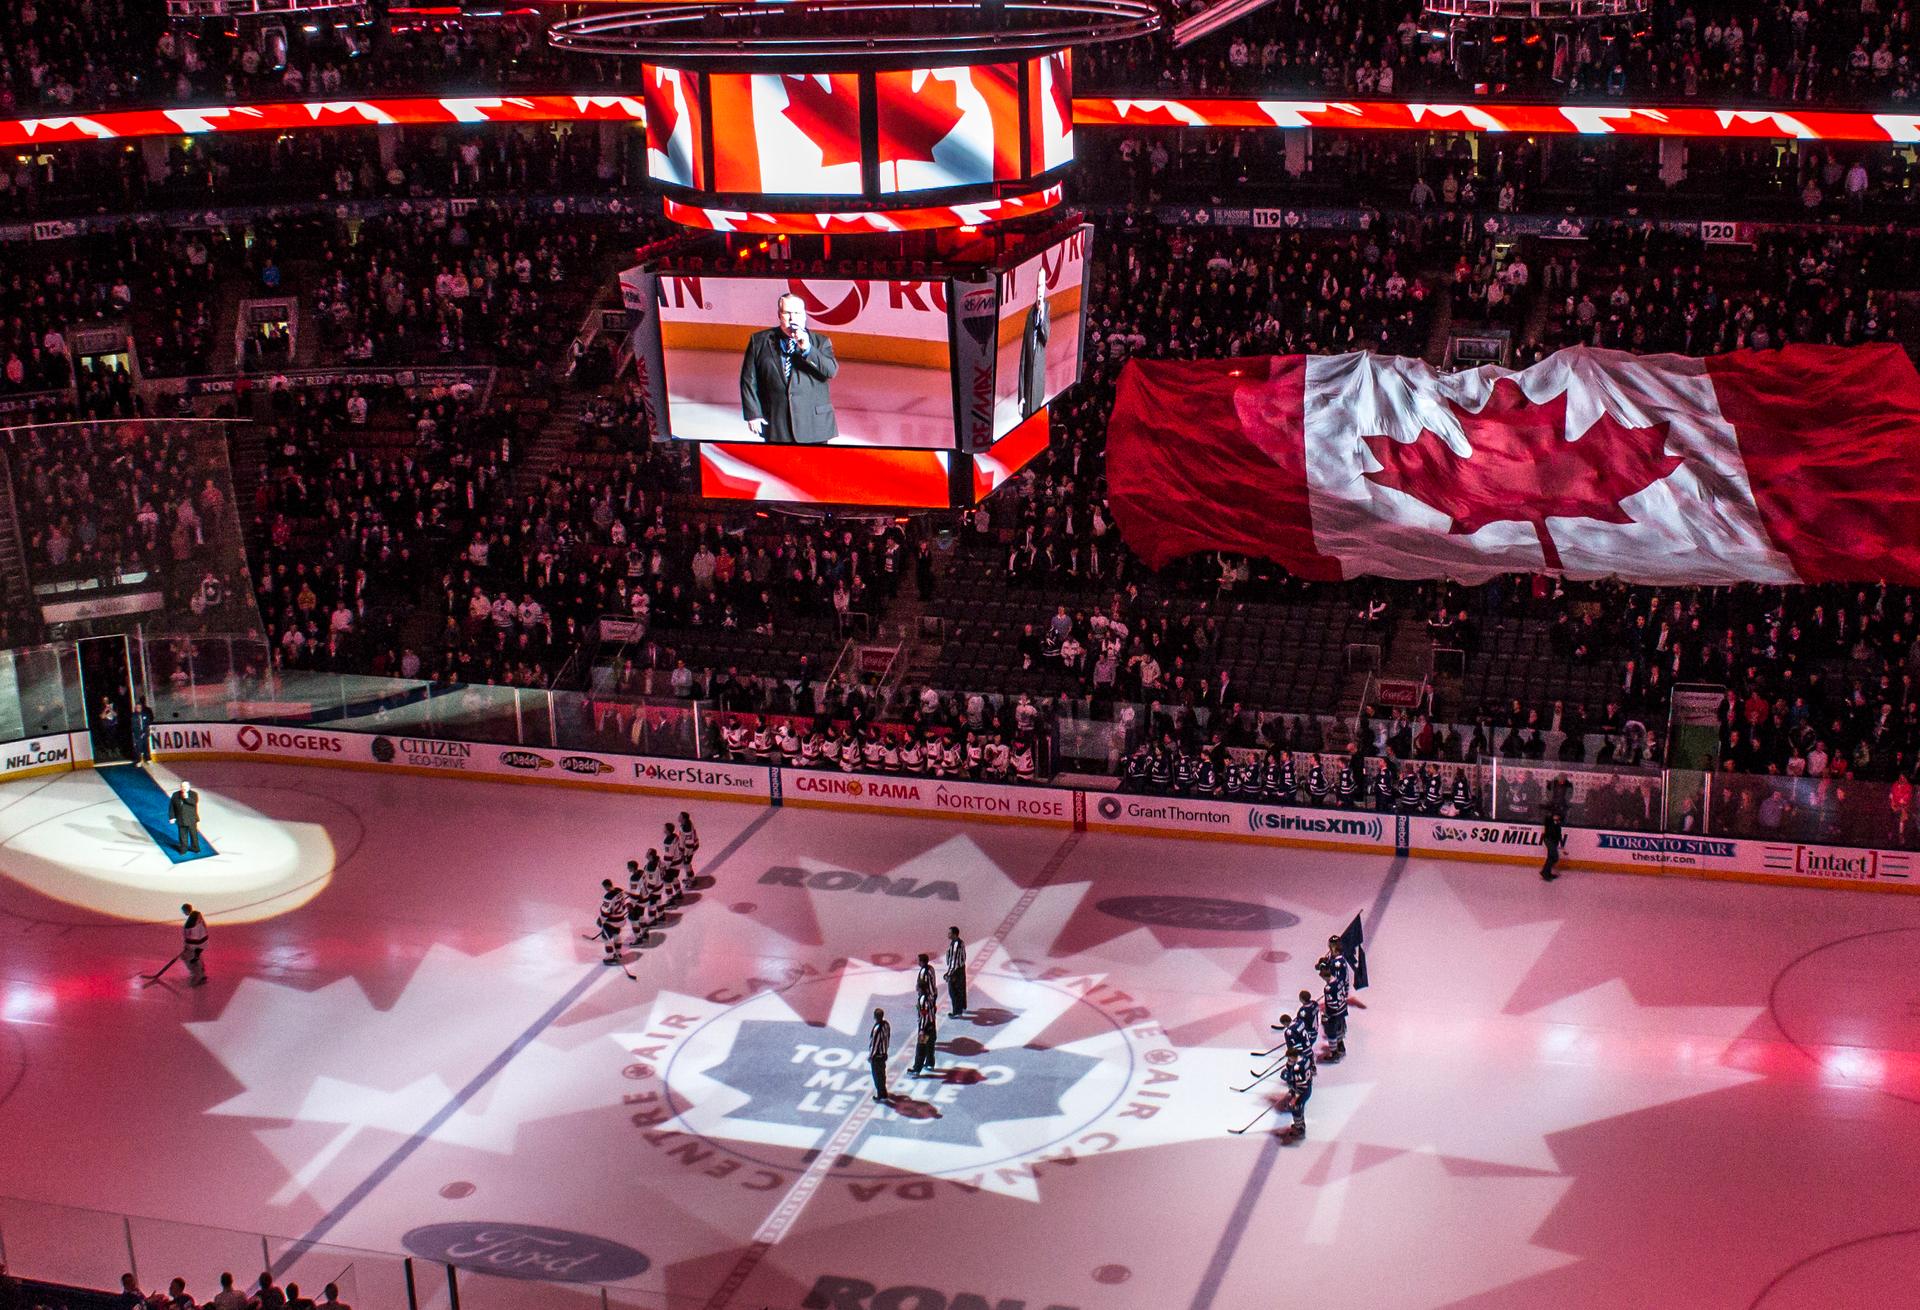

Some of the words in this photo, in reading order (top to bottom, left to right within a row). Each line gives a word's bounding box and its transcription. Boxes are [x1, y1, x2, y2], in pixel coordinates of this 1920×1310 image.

[1256, 211, 1280, 225] 119
[37, 223, 61, 238] 116
[1703, 225, 1735, 239] 120
[970, 362, 994, 449] RE/MAX
[266, 732, 342, 752] ROGERS
[400, 739, 471, 757] CITIZEN
[6, 747, 68, 769] NHL.COM
[408, 755, 465, 769] ECO-DRIVE
[868, 782, 920, 800] RAMA
[936, 793, 1010, 811] NORTON
[1018, 799, 1063, 816] ROSE
[1128, 803, 1166, 820] Grant
[1167, 806, 1230, 824] Thornton
[1502, 829, 1568, 849] MILLIN
[1606, 834, 1682, 852] TORONTO
[1686, 839, 1728, 856] STAR
[1632, 852, 1696, 866] thestar.com
[757, 865, 962, 901] RONA
[630, 1013, 701, 1061] AIR
[1117, 1068, 1182, 1121] AIR
[623, 1091, 785, 1191] CENTRE
[447, 1231, 600, 1273] Ford
